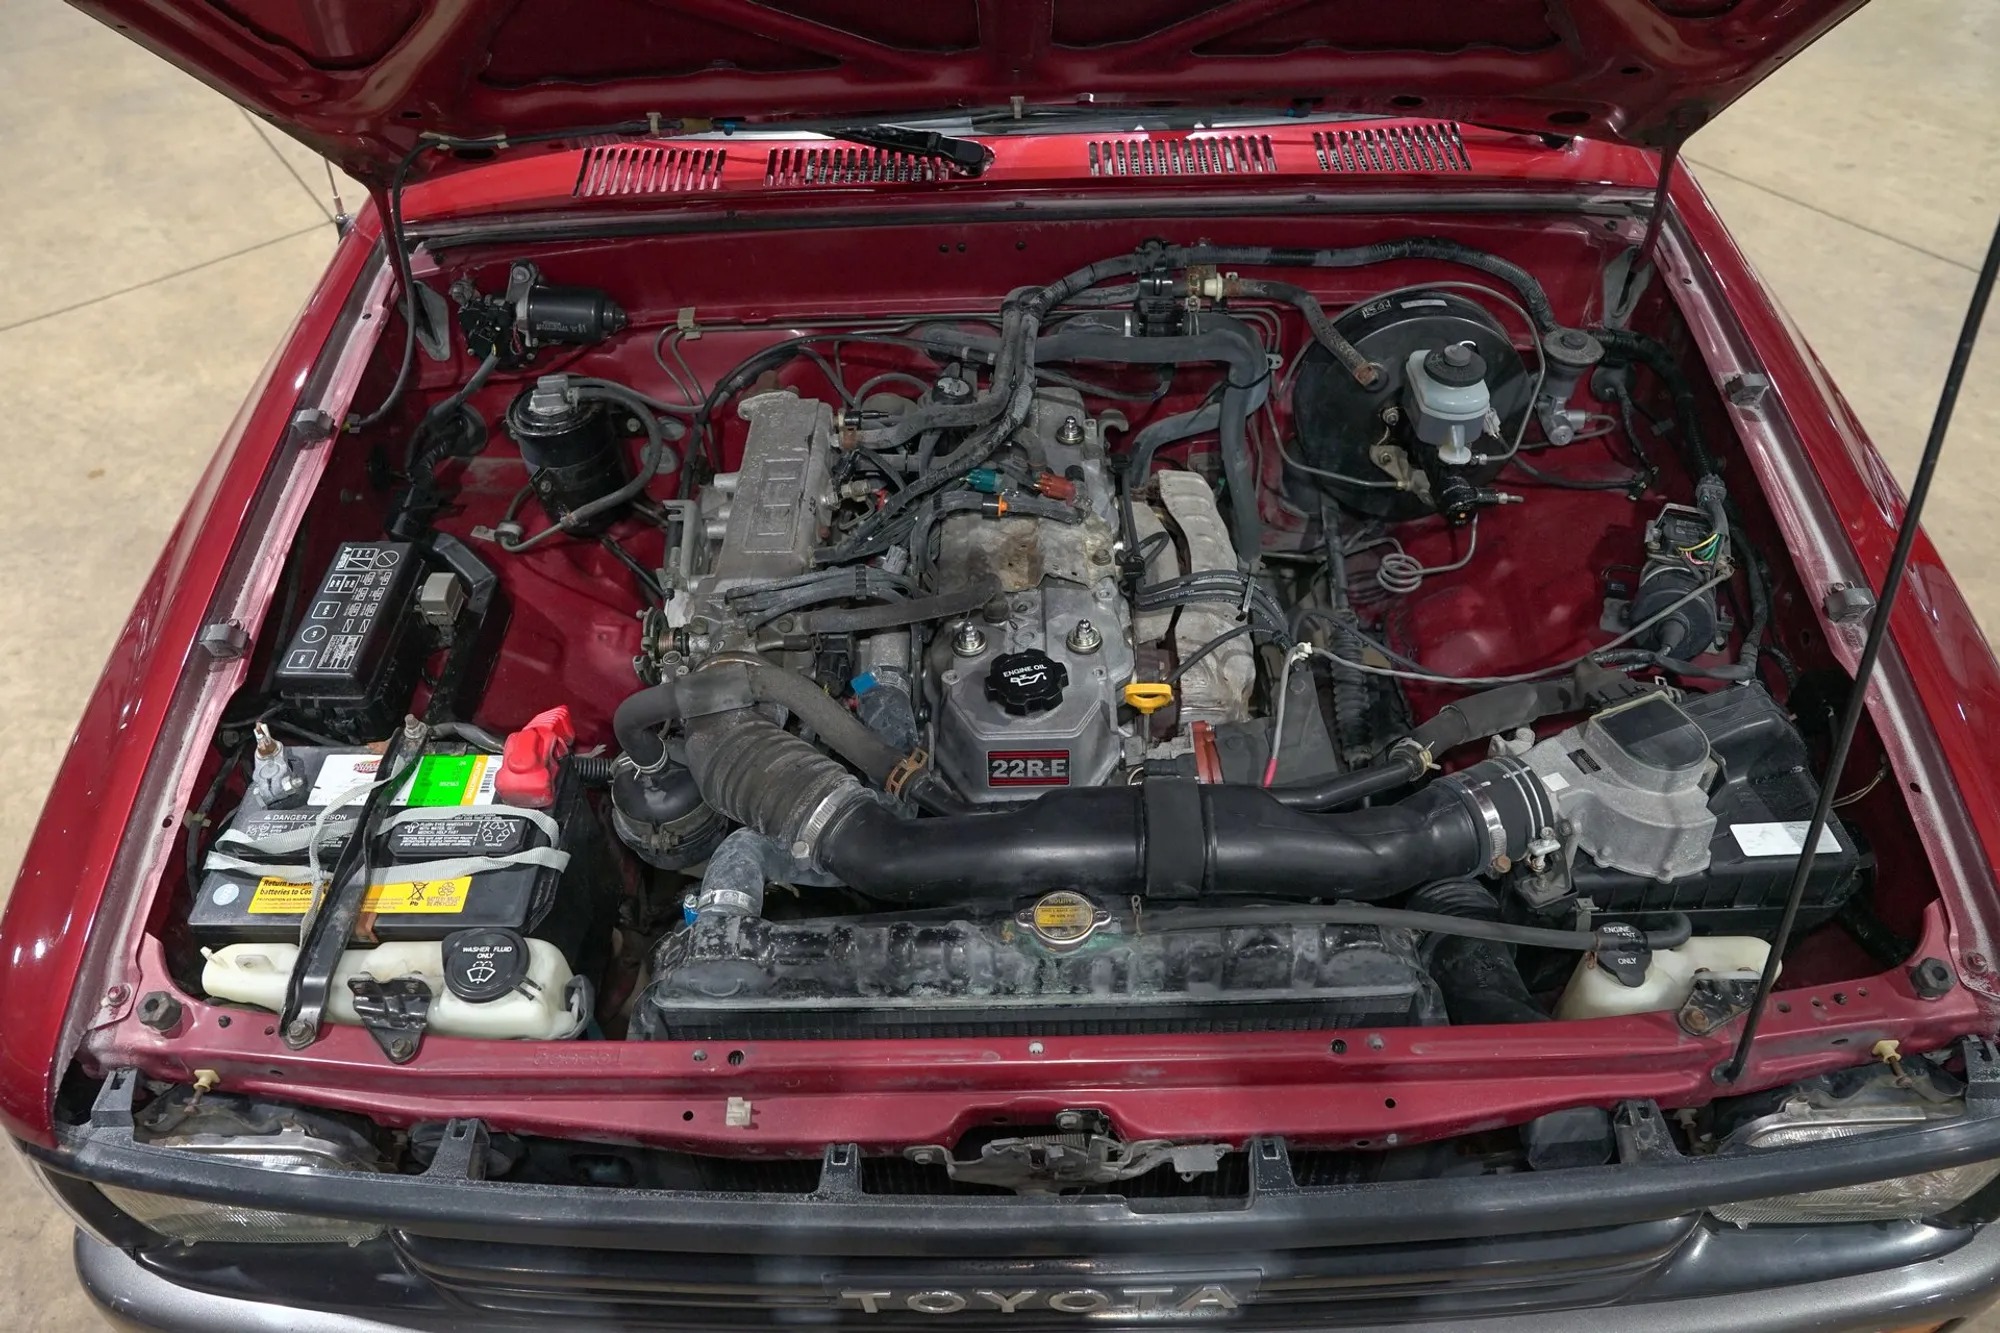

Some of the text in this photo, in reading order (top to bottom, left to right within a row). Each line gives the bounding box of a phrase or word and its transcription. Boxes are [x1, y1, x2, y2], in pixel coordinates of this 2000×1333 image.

[1003, 665, 1033, 678] ENGINE
[991, 759, 1067, 778] 22R-E
[1617, 957, 1637, 965] ONLY
[841, 1285, 1239, 1314] TOYOTA
